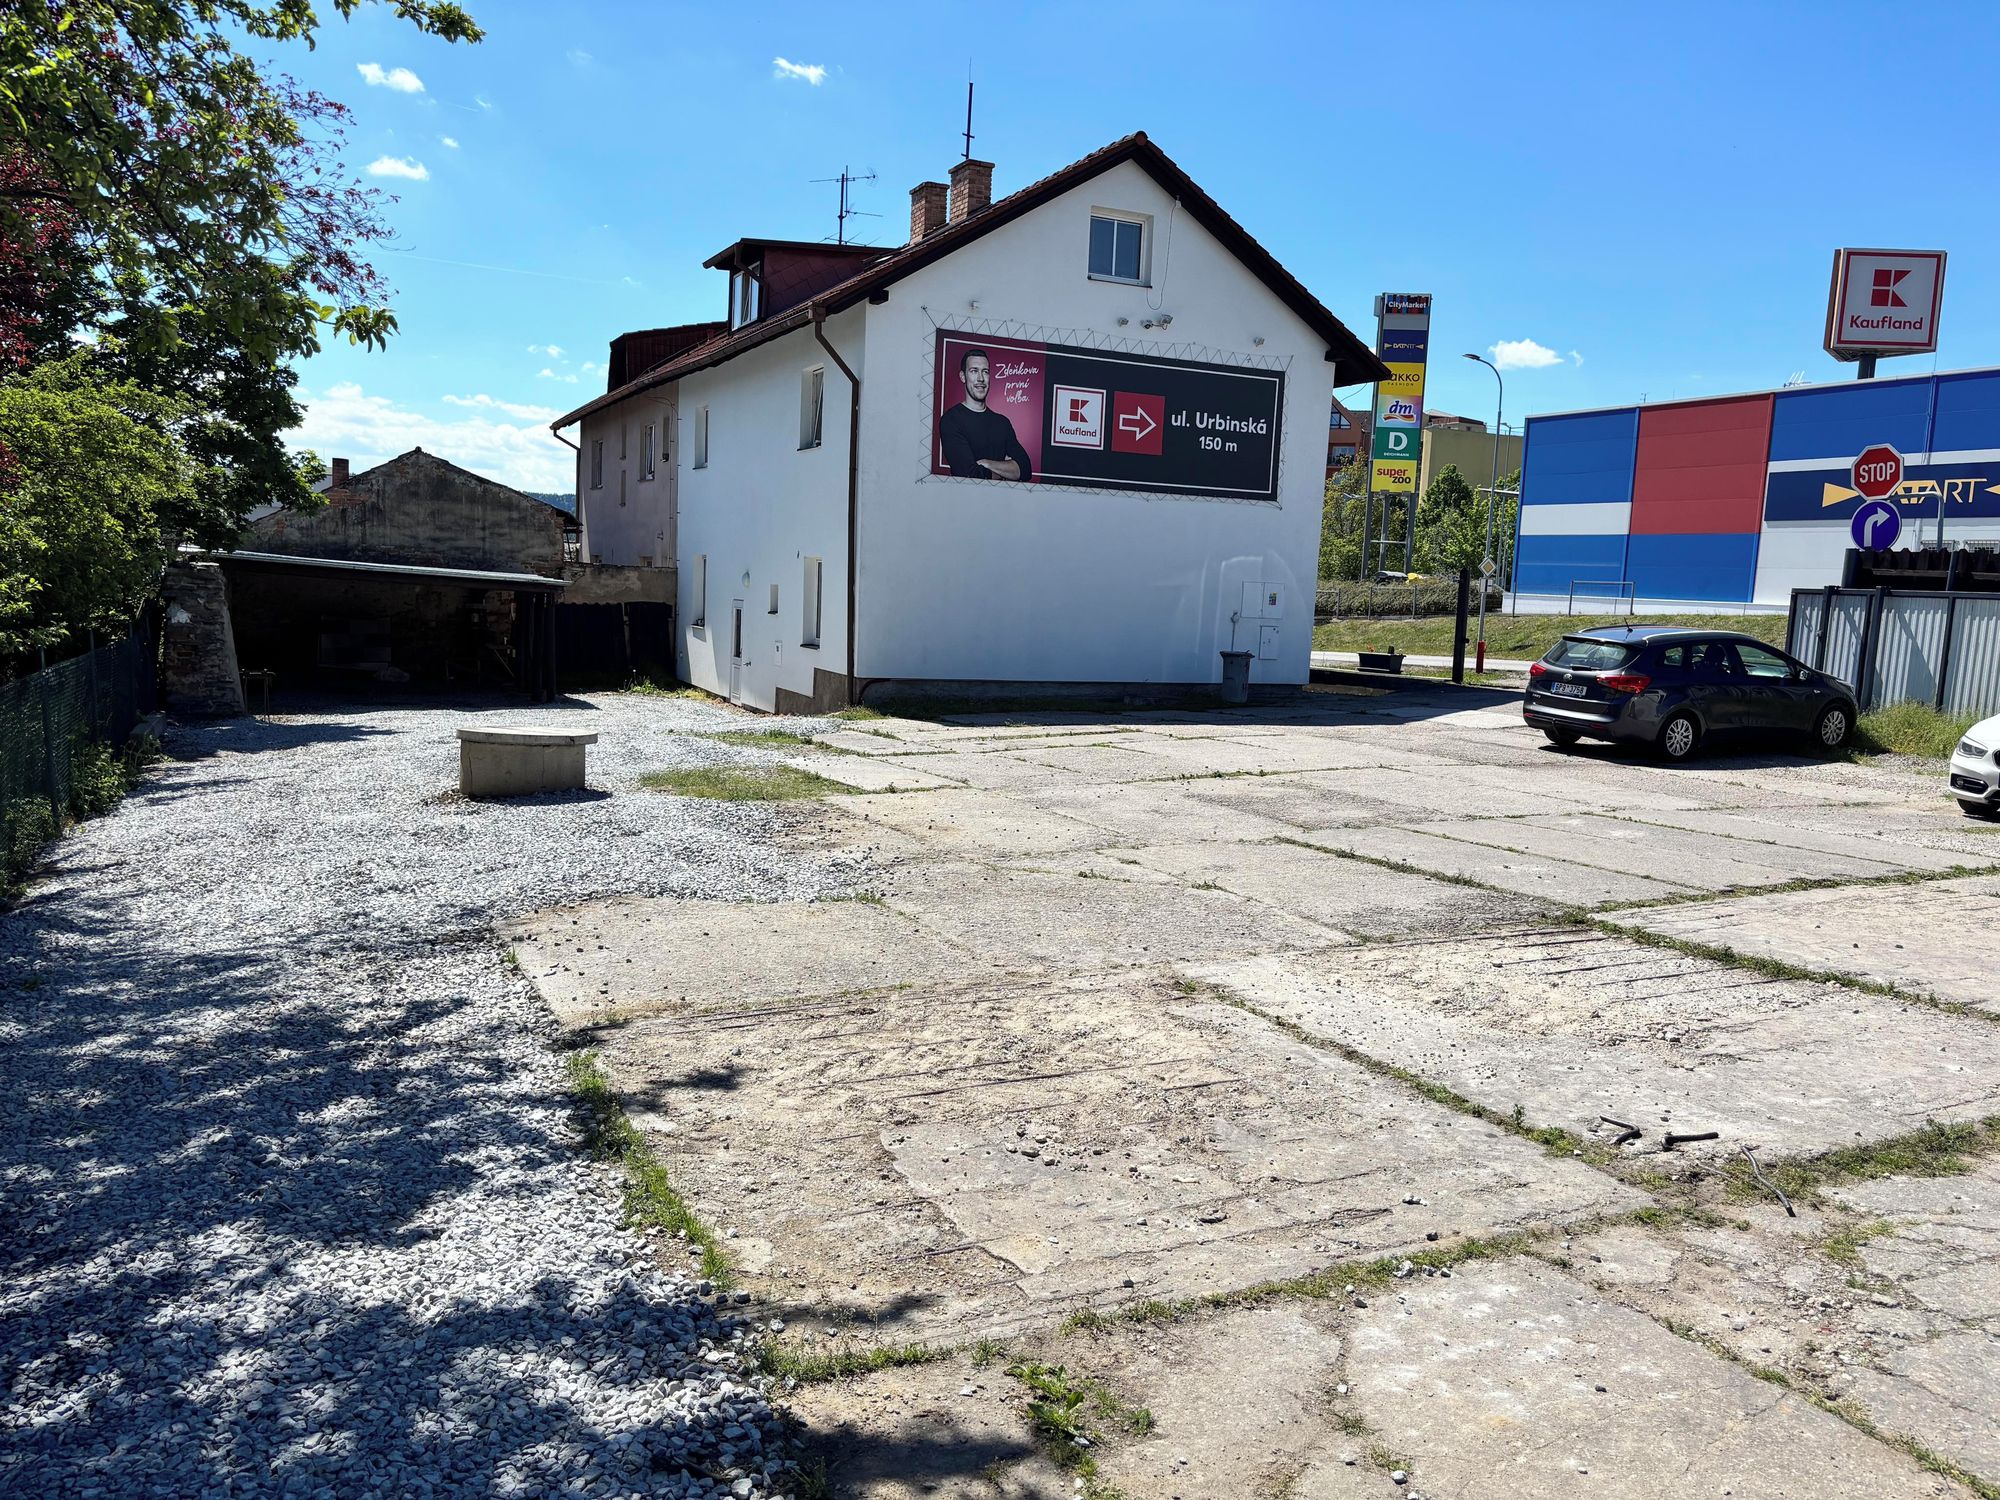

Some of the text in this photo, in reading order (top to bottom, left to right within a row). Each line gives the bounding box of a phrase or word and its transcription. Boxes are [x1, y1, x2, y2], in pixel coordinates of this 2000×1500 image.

[1388, 301, 1427, 309] CityMarket
[1849, 315, 1924, 330] Kaufland
[995, 362, 1039, 378] Zdeňkova
[1004, 379, 1030, 396] první
[1389, 400, 1413, 415] dm
[1171, 410, 1267, 435] ul. Urbinská
[1059, 425, 1097, 438] Kaufland
[1199, 436, 1238, 453] 150 m
[1388, 431, 1408, 451] D
[1376, 468, 1408, 478] super
[1391, 476, 1412, 484] zoo
[1859, 461, 1896, 484] STOP
[1890, 478, 1988, 504] ATART
